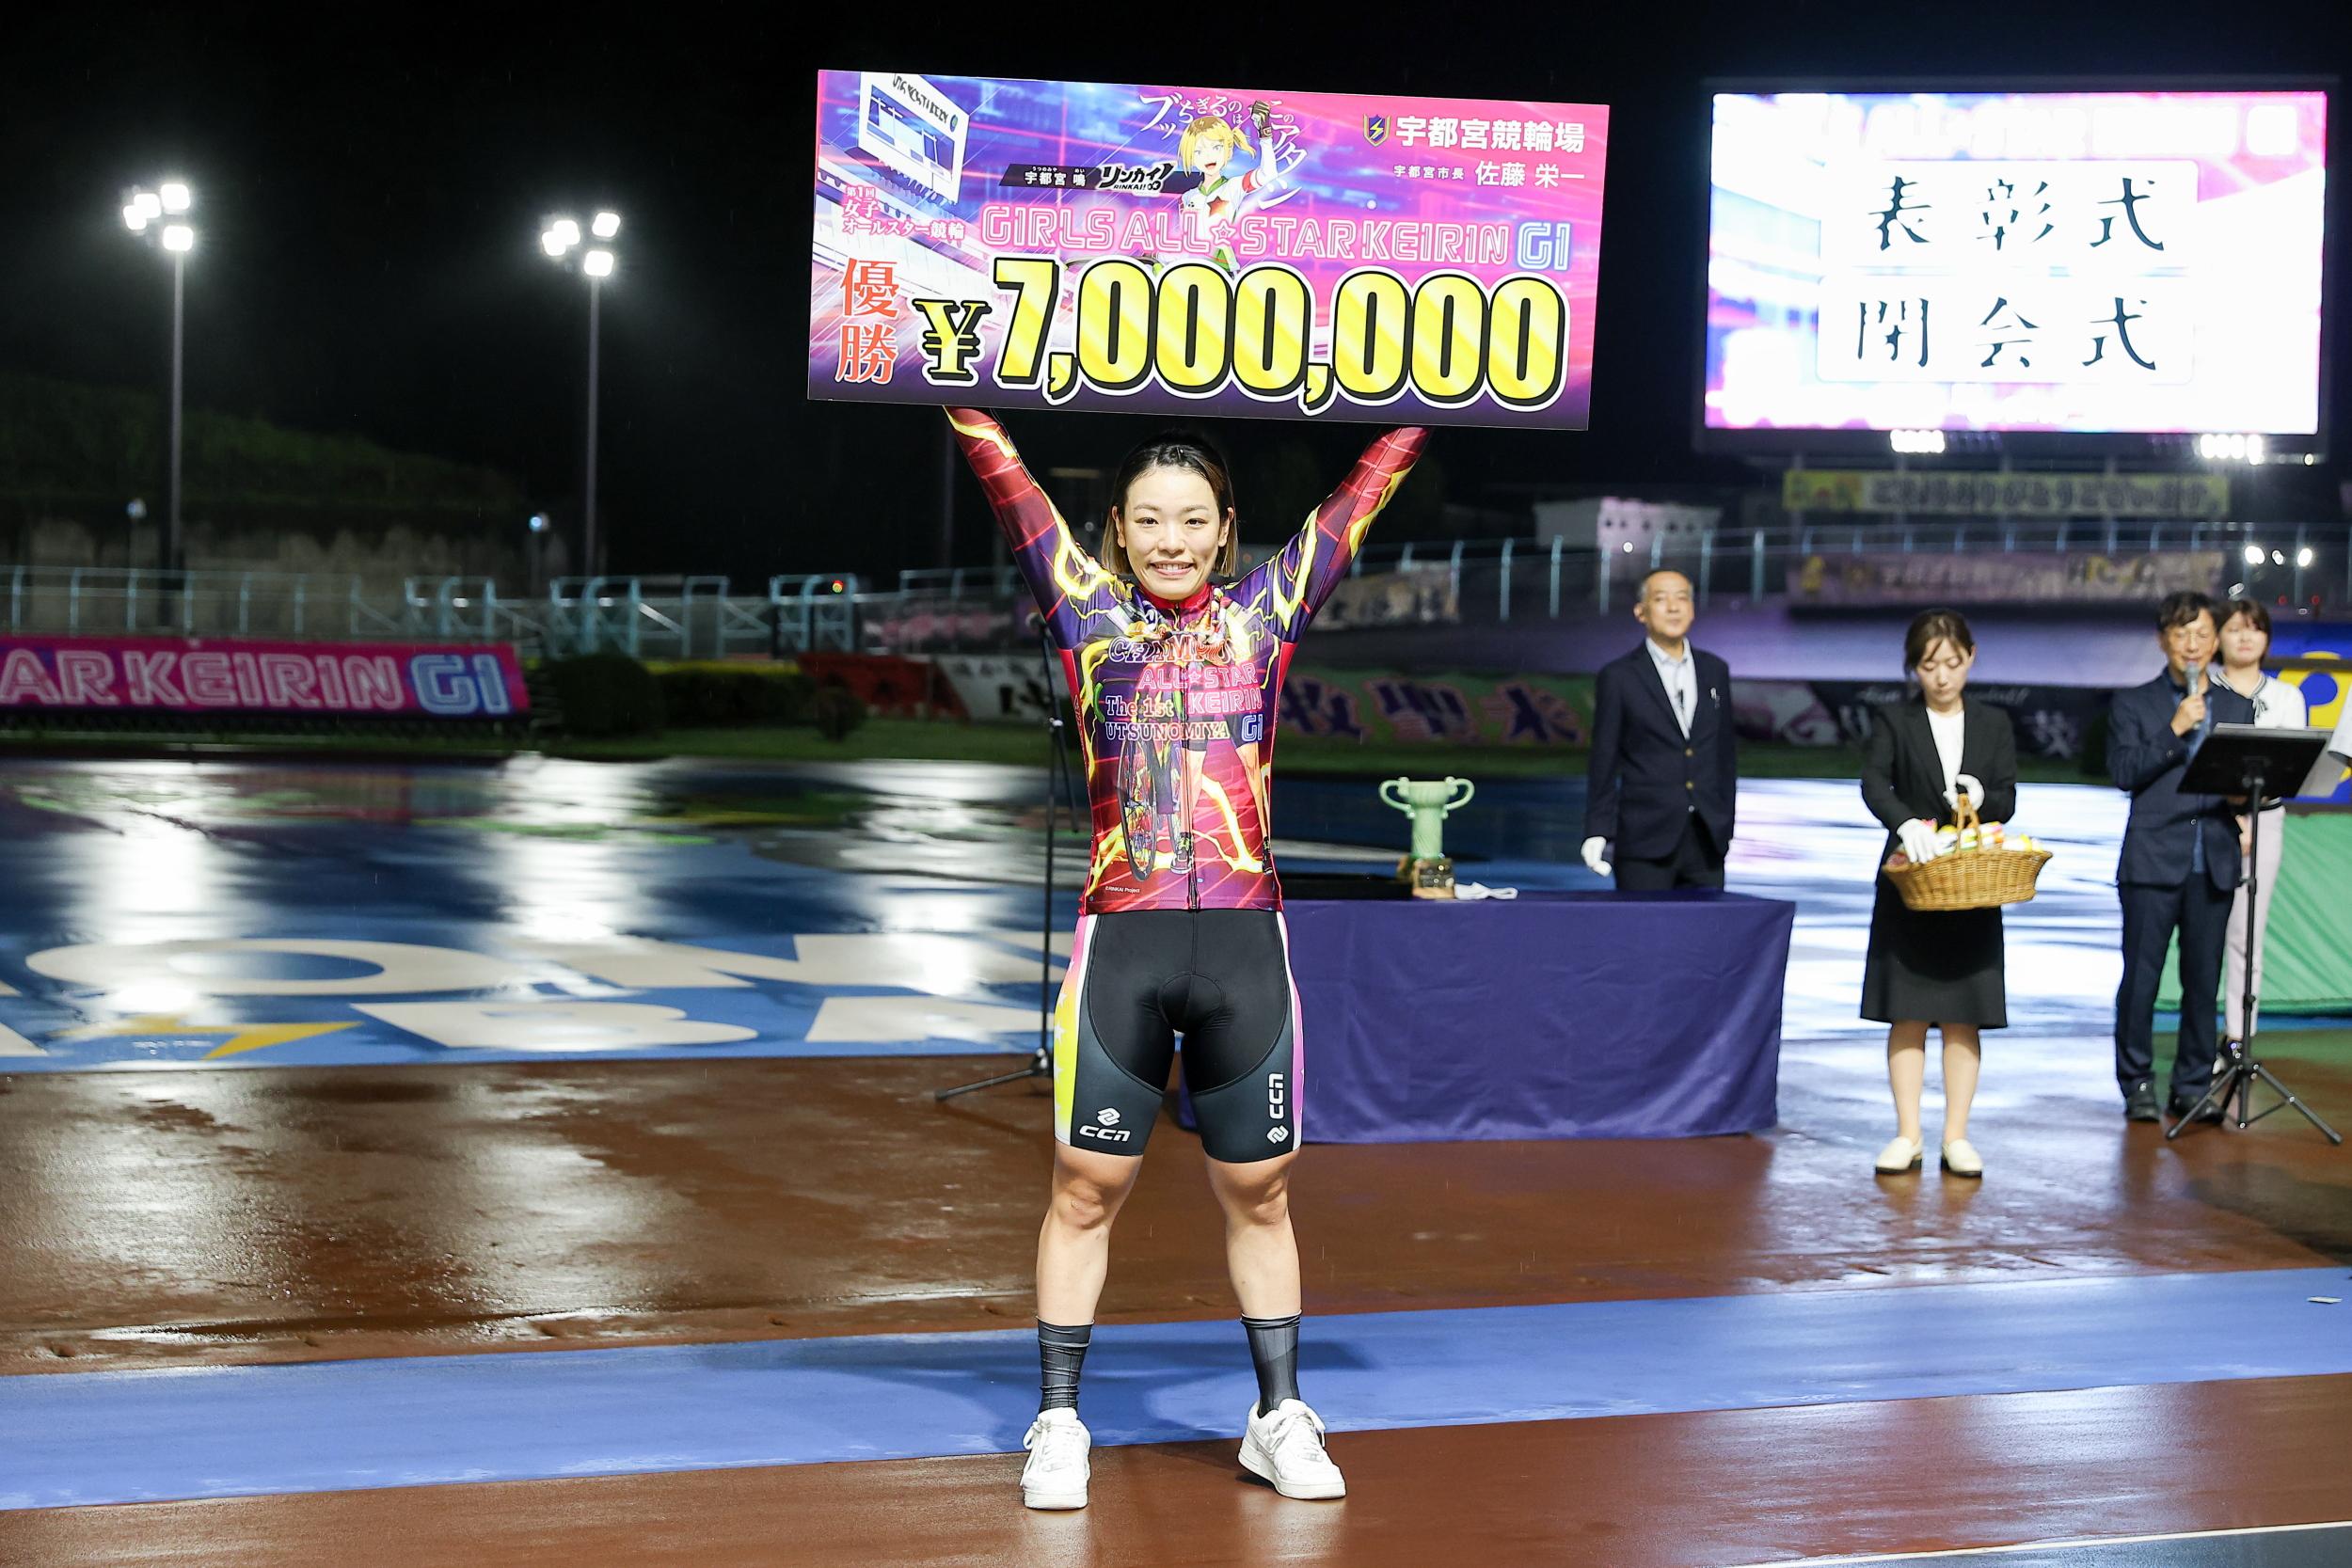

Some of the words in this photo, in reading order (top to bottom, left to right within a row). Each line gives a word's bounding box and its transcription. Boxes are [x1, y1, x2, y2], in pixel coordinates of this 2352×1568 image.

[1396, 115, 1585, 153] 宇都宮競輪場
[1025, 171, 1067, 186] 宇都宮
[1073, 173, 1087, 187] 鳴
[1393, 165, 1466, 181] 宇都宮市長
[1474, 160, 1526, 187] 佐藤
[1534, 163, 1585, 188] 栄一
[843, 198, 879, 219] 女子
[1867, 175, 2165, 251] 表彰式
[843, 218, 965, 240] オールスター競輪
[981, 205, 1113, 250] GIRLS
[1361, 220, 1508, 265] KEIRIN
[834, 258, 899, 384] 優勝
[912, 257, 1568, 412] ¥7,000,000
[1856, 297, 2156, 371] 閉会式
[126, 650, 405, 711] KEIRIN
[1105, 696, 1138, 716] The
[1142, 695, 1175, 718] 1st
[1187, 688, 1263, 715] KEIRIN
[1104, 721, 1231, 742] UTSUNOMIYA
